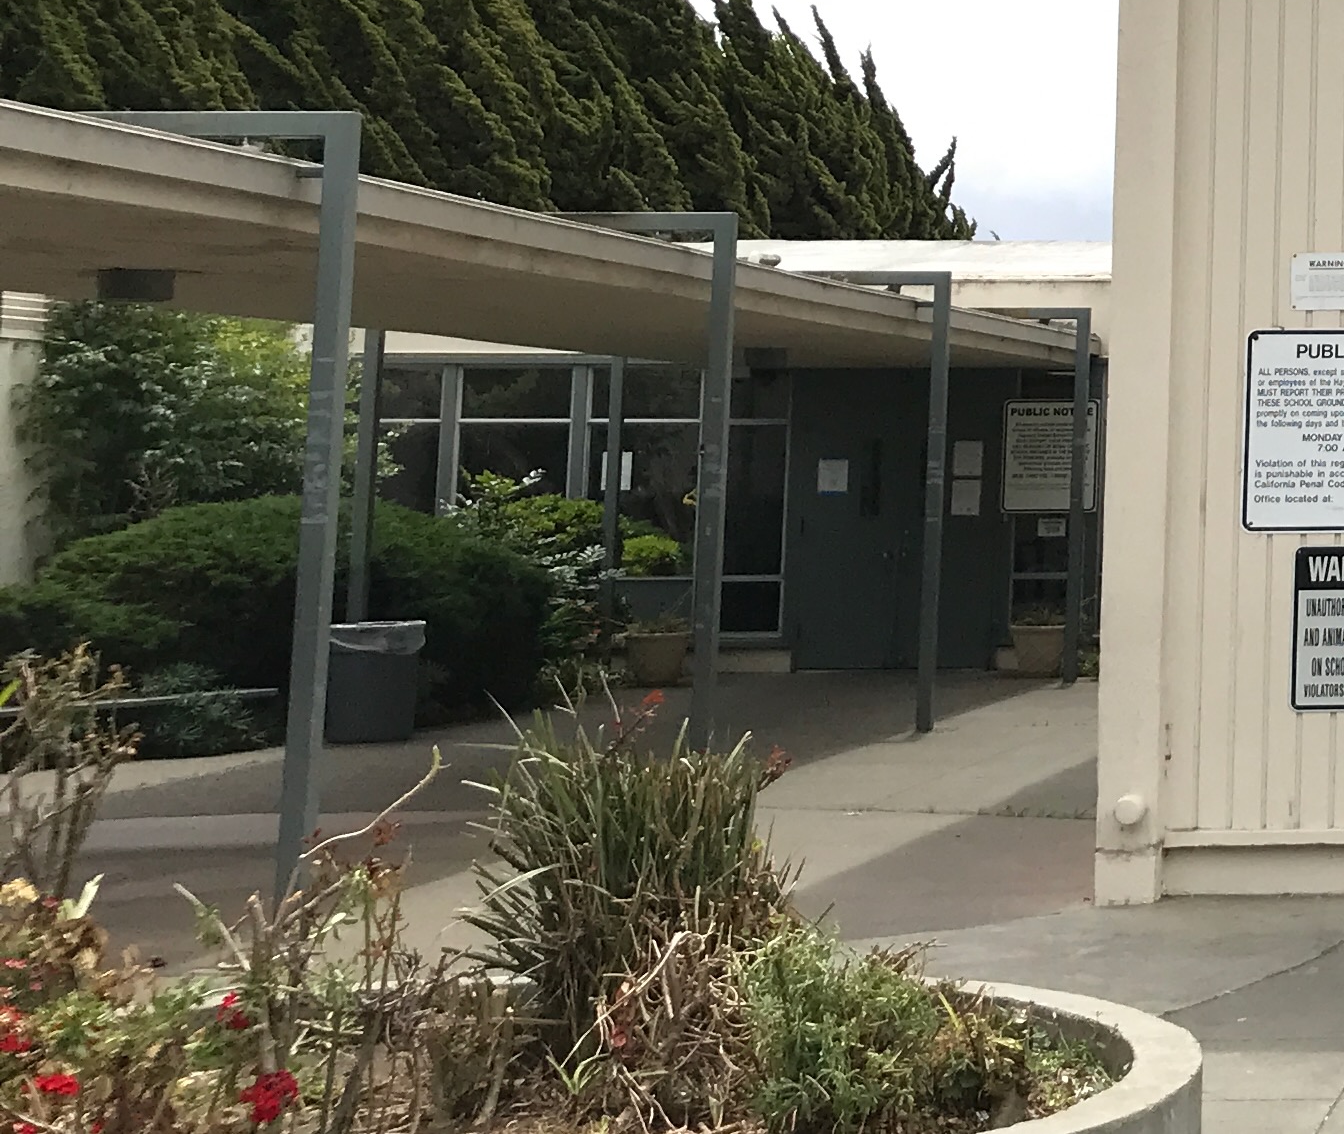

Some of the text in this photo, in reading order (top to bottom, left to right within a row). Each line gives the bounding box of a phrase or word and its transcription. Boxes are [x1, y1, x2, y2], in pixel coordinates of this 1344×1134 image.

[1258, 368, 1271, 376] ALL
[1313, 368, 1337, 377] except
[1268, 378, 1306, 387] employees
[1309, 378, 1317, 386] of
[1320, 378, 1331, 386] the
[1257, 388, 1277, 396] MUST
[1280, 388, 1309, 396] REPORT
[1312, 388, 1333, 396] THEIR
[1258, 399, 1280, 407] THESE
[1284, 399, 1313, 407] SCHOOL
[1011, 407, 1093, 416] PUBLIC NOTE
[1256, 409, 1287, 418] promptly
[1302, 409, 1328, 418] coming
[1271, 420, 1302, 429] following
[1305, 420, 1322, 429] days
[1302, 433, 1343, 442] MONDAY
[1255, 459, 1293, 468] Violation
[1297, 459, 1306, 467] of
[1311, 459, 1326, 467] this
[1254, 470, 1262, 478] is
[1266, 470, 1313, 480] punishable
[1317, 470, 1325, 478] in
[1254, 480, 1296, 488] California
[1300, 480, 1324, 488] Penal
[1254, 495, 1281, 503] Office
[1285, 494, 1318, 503] located
[1304, 628, 1319, 646] AND
[1312, 657, 1322, 676] ON
[1304, 684, 1344, 697] VIOLATORS
